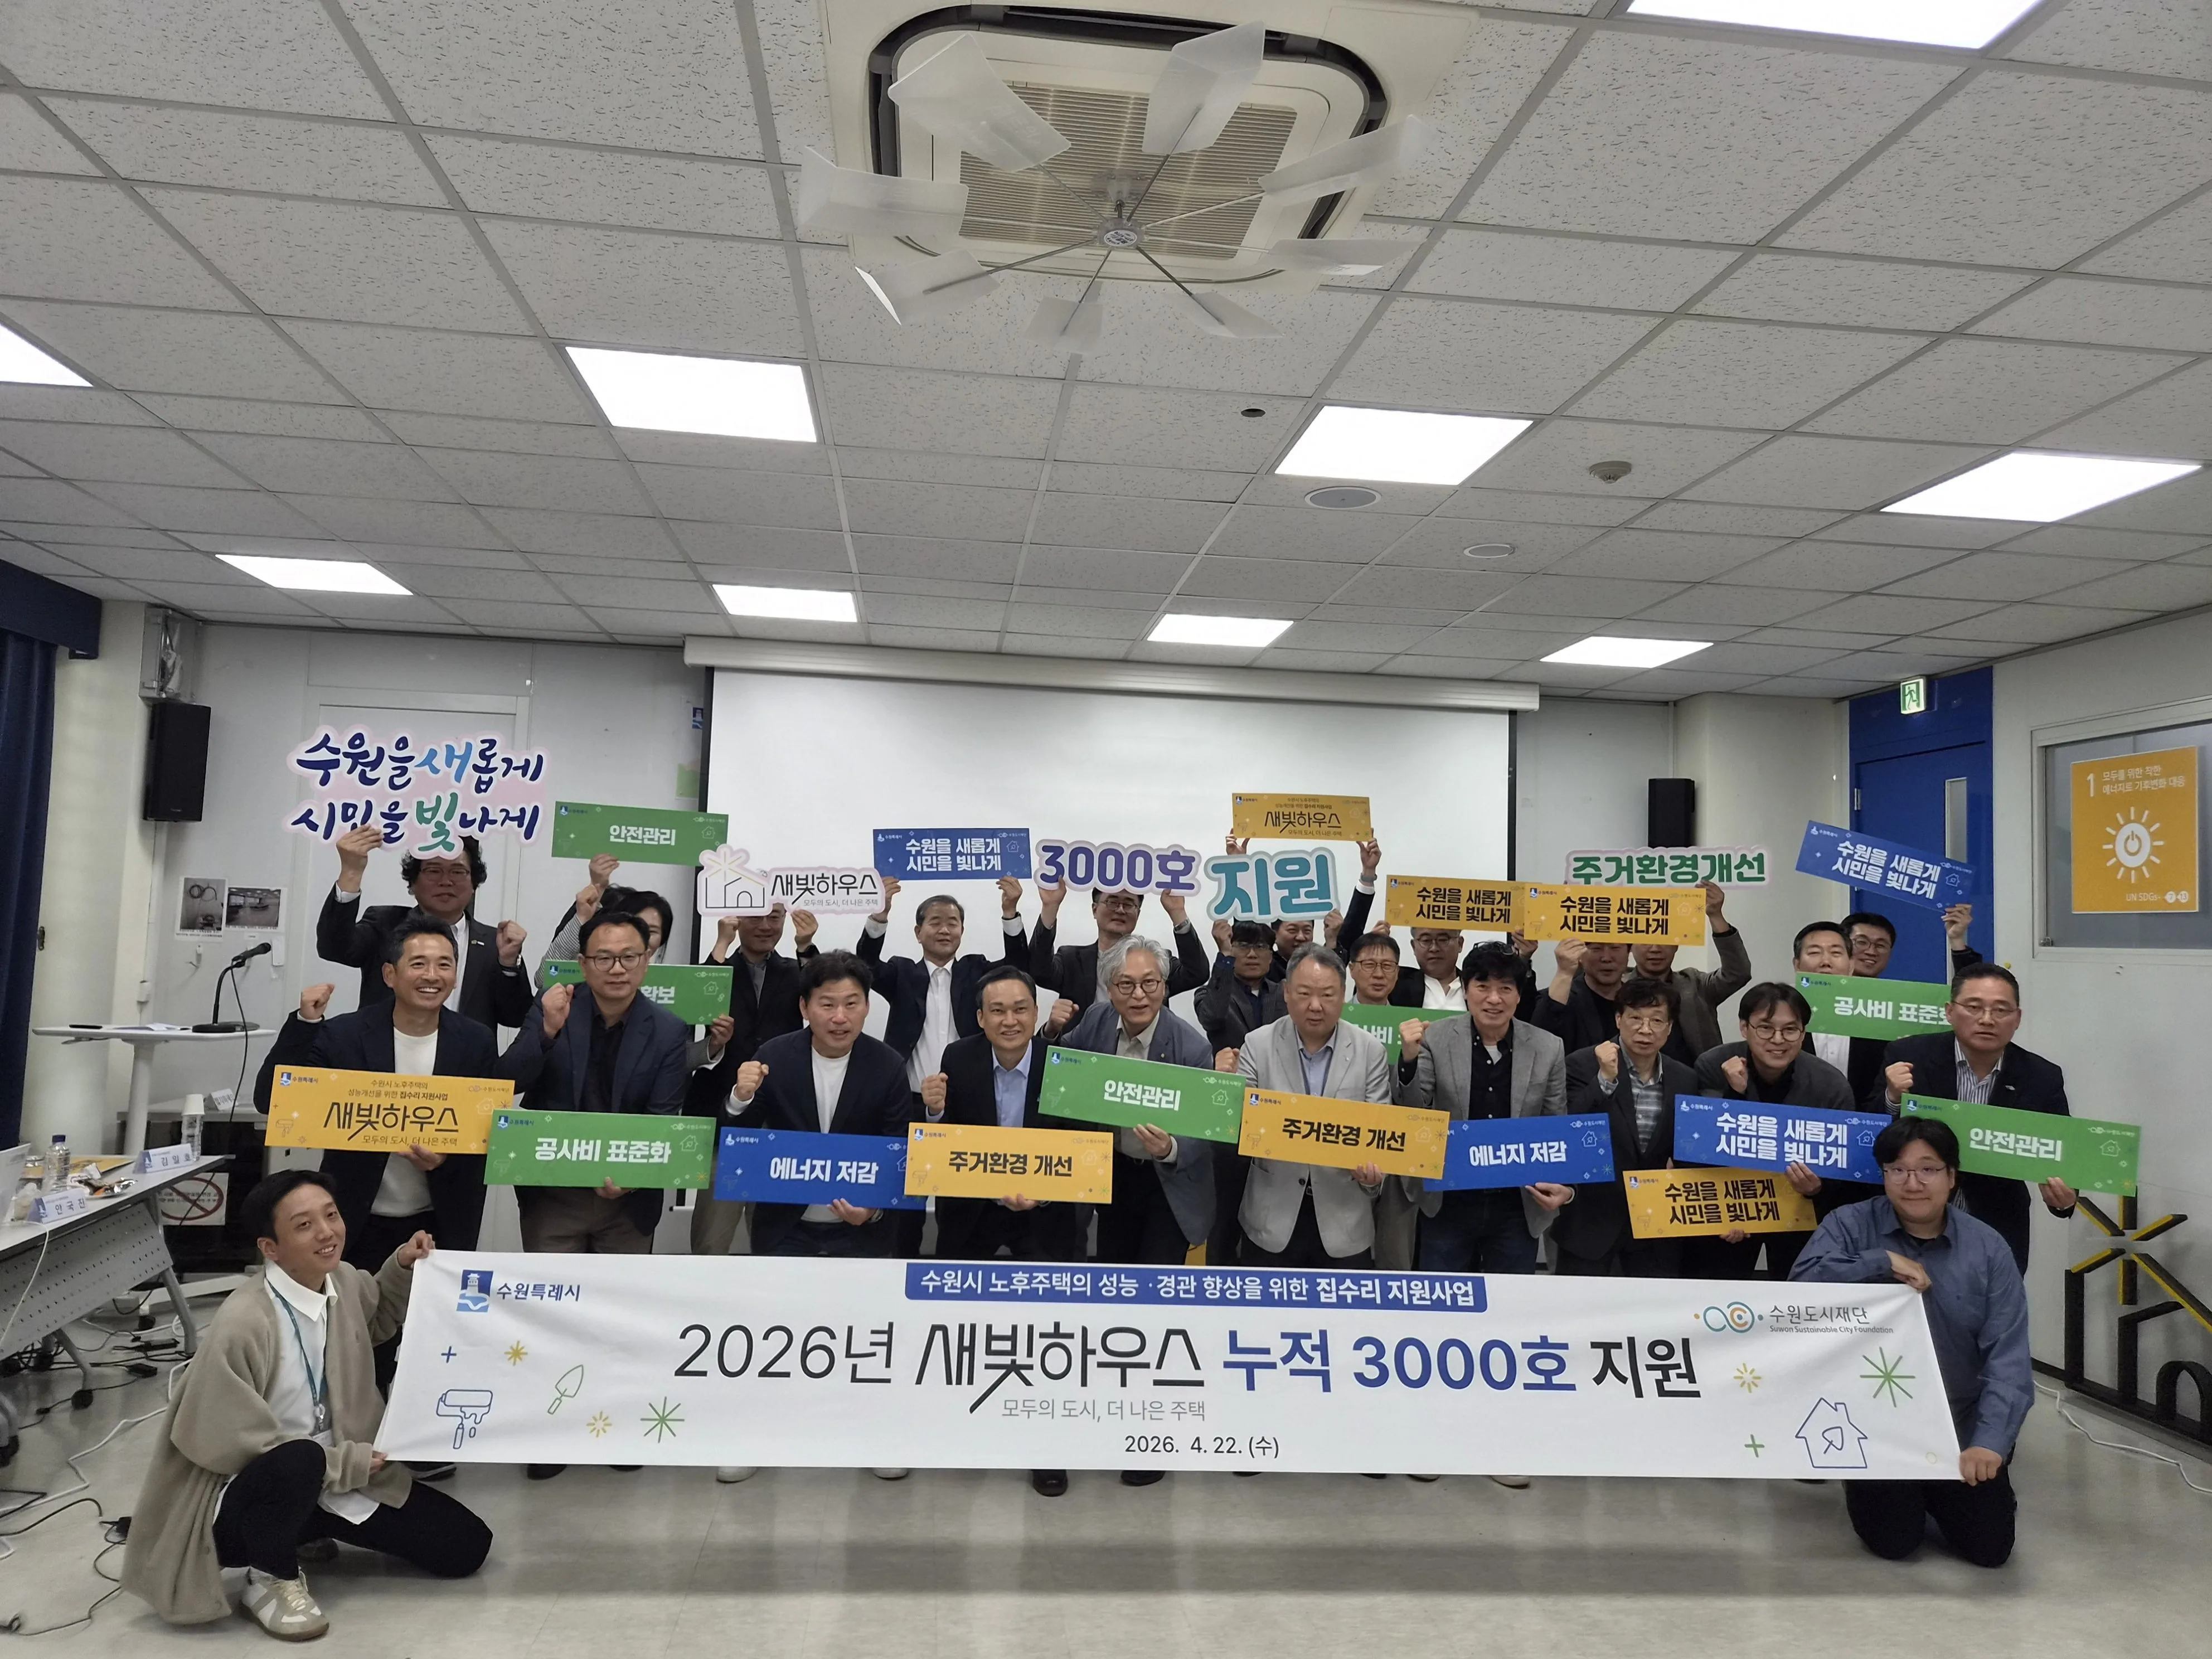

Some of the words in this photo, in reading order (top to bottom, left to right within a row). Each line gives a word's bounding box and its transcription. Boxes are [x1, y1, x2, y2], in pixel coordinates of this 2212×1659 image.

[296, 732, 415, 791] 수원을
[414, 739, 544, 794] 새롭게
[2087, 773, 2094, 797] 1
[415, 792, 540, 852] 빛나게
[1264, 811, 1341, 833] 새빛하우스
[610, 824, 676, 846] 안전관리
[905, 838, 951, 855] 수원을
[956, 838, 1001, 854] 새롭게
[906, 855, 952, 872] 시민을
[957, 855, 1001, 871] 빛나게
[1040, 845, 1195, 890] 3000호
[1572, 852, 1765, 885] 주거환경개선
[1837, 841, 1888, 867] 수원을
[1889, 854, 1941, 882] 새롭게
[771, 873, 878, 905] 새빛하우스
[1210, 853, 1333, 916] 지원
[1831, 857, 1883, 885] 시민을
[1885, 871, 1937, 899] 빛나게
[804, 899, 823, 907] 모두의
[825, 899, 840, 908] 도시,
[842, 899, 849, 907] 더
[1417, 887, 1462, 904] 수원을
[1466, 889, 1511, 906] 새롭게
[1560, 896, 1612, 914] 수원을
[1617, 897, 1668, 916] 새롭게
[1416, 904, 1461, 921] 시민을
[1466, 906, 1510, 924] 빛나게
[1560, 914, 1612, 933] 시민을
[1617, 916, 1668, 935] 빛나게
[1834, 996, 1893, 1020] 공사비
[400, 1090, 420, 1099] 집수리
[421, 1092, 448, 1101] 지원사업
[1104, 1079, 1181, 1111] 안전관리
[323, 1102, 459, 1141] 새빛하우스
[1716, 1112, 1778, 1138] 수원을
[1784, 1118, 1847, 1146] 새롭게
[362, 1134, 388, 1144] 모두의
[390, 1136, 410, 1147] 도시,
[422, 1137, 439, 1146] 나은
[441, 1137, 458, 1147] 주택
[1282, 1118, 1361, 1146] 주거환경
[1366, 1128, 1406, 1152] 개선
[1970, 1127, 2063, 1162] 안전관리
[535, 1138, 601, 1162] 공사비
[606, 1140, 671, 1163] 표준화
[1469, 1143, 1526, 1167] 에너지
[1530, 1141, 1567, 1163] 저감
[1715, 1135, 1777, 1161] 시민을
[1784, 1142, 1847, 1169] 빛나게
[770, 1157, 832, 1182] 에너지
[836, 1161, 879, 1185] 저감
[949, 1151, 1028, 1175] 주거환경
[1034, 1154, 1072, 1177] 개선
[1665, 1181, 1718, 1203] 수원을
[1724, 1178, 1776, 1200] 새롭게
[1670, 1204, 1723, 1225] 시민을
[1728, 1201, 1781, 1223] 빛나게
[497, 1283, 580, 1302] 수원특례시
[920, 1269, 983, 1294] 수원시
[989, 1272, 1091, 1296] 노후주택의
[1098, 1273, 1139, 1297] 성능
[1202, 1275, 1263, 1300] 향상을
[1269, 1277, 1308, 1301] 위한
[1316, 1278, 1381, 1304] 집수리
[1388, 1279, 1474, 1307] 지원사업
[1769, 1305, 1869, 1325] 수원도시재단
[674, 1321, 894, 1384] 2026년
[915, 1321, 1205, 1414] 새빛하우스
[1223, 1329, 1331, 1393] 누적
[1352, 1335, 1577, 1391] 3000호
[1590, 1336, 1701, 1399] 지원
[1001, 1399, 1055, 1420] 모두의
[1061, 1399, 1101, 1423] 도시,
[1107, 1399, 1124, 1420] 더
[1130, 1400, 1165, 1421] 나은
[1170, 1400, 1206, 1422] 주택
[1124, 1435, 1180, 1454] 2026.
[1190, 1436, 1207, 1454] 4.
[1213, 1436, 1243, 1454] 22.
[1249, 1436, 1279, 1459] (수)
